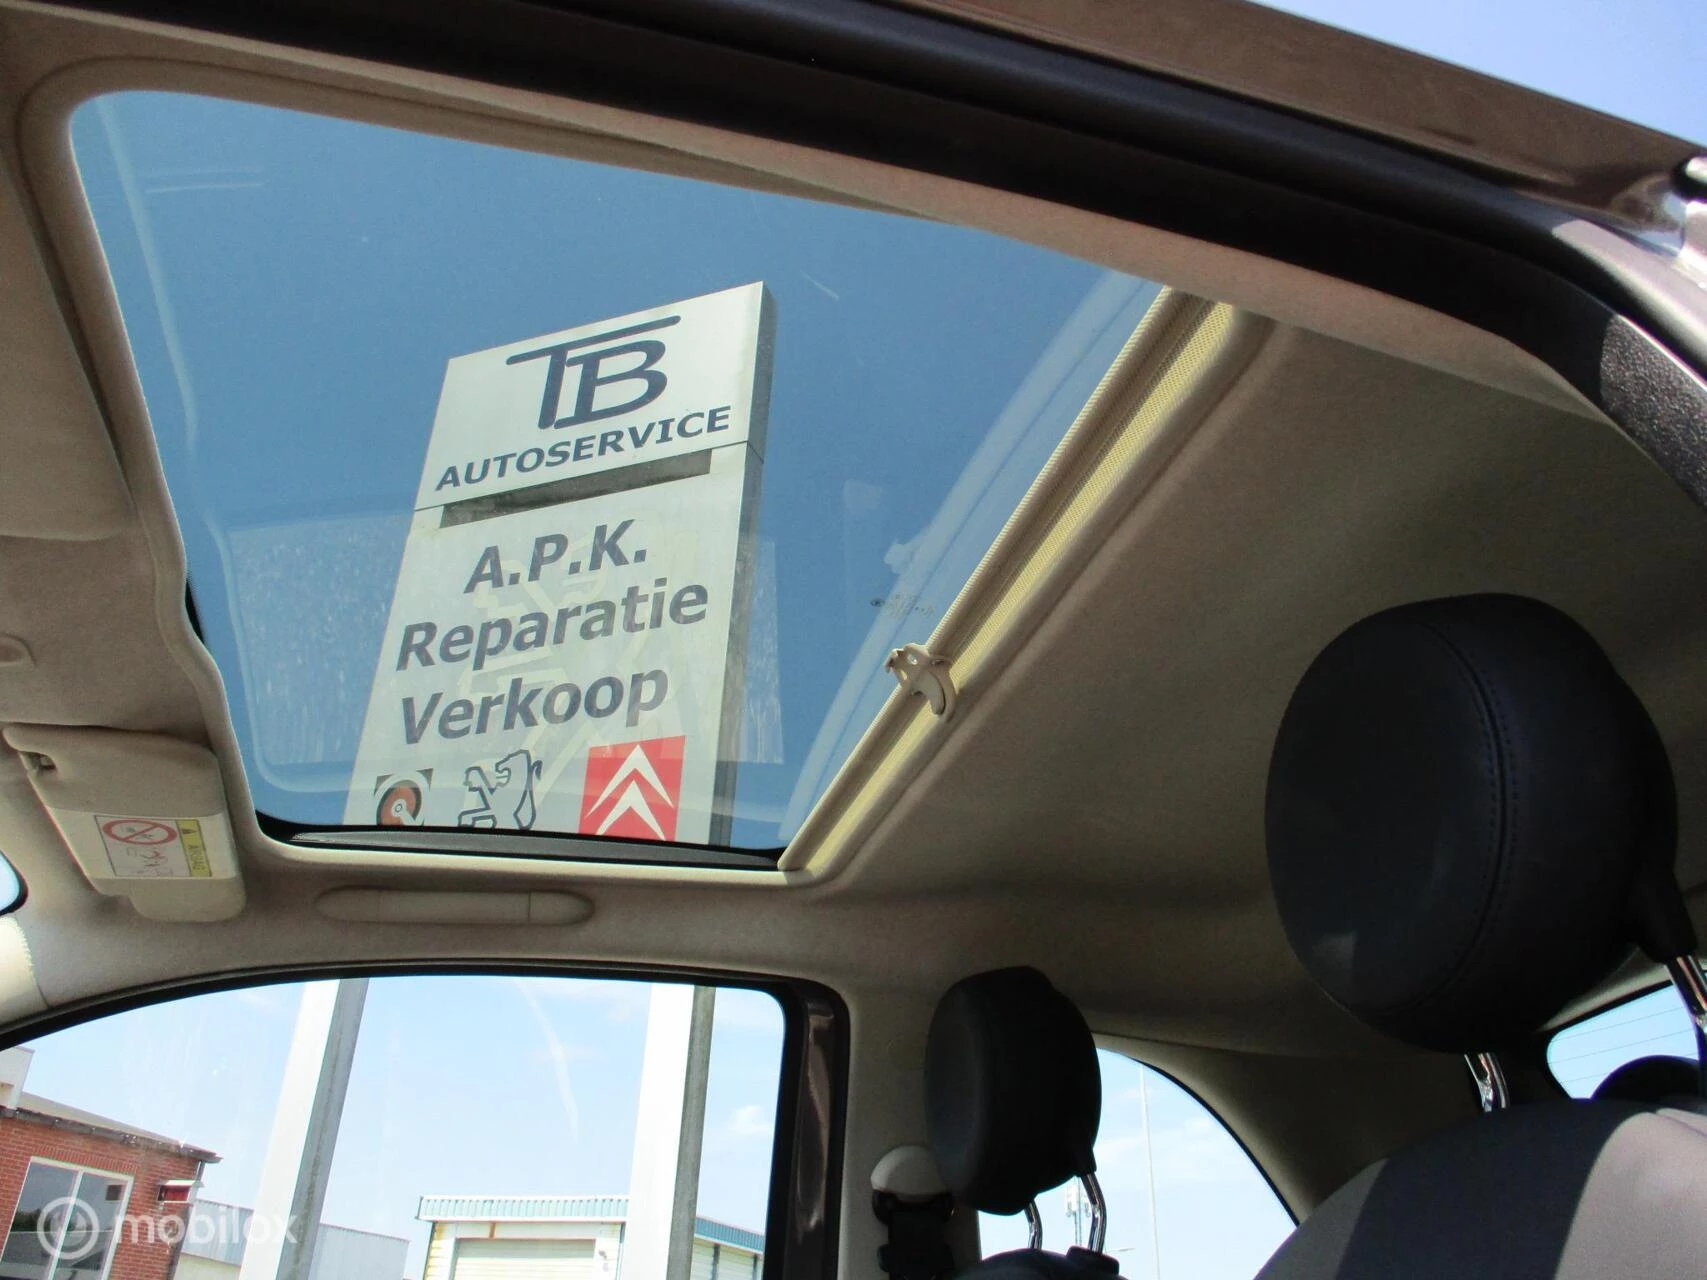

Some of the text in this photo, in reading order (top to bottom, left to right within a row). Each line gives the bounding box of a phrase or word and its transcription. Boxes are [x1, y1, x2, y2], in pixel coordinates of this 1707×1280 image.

[505, 315, 682, 430] TB
[435, 406, 732, 492] AUTOSERVICE
[463, 519, 648, 594] A.P.K.
[396, 577, 709, 671] Reparatie
[401, 668, 669, 744] Verkoop
